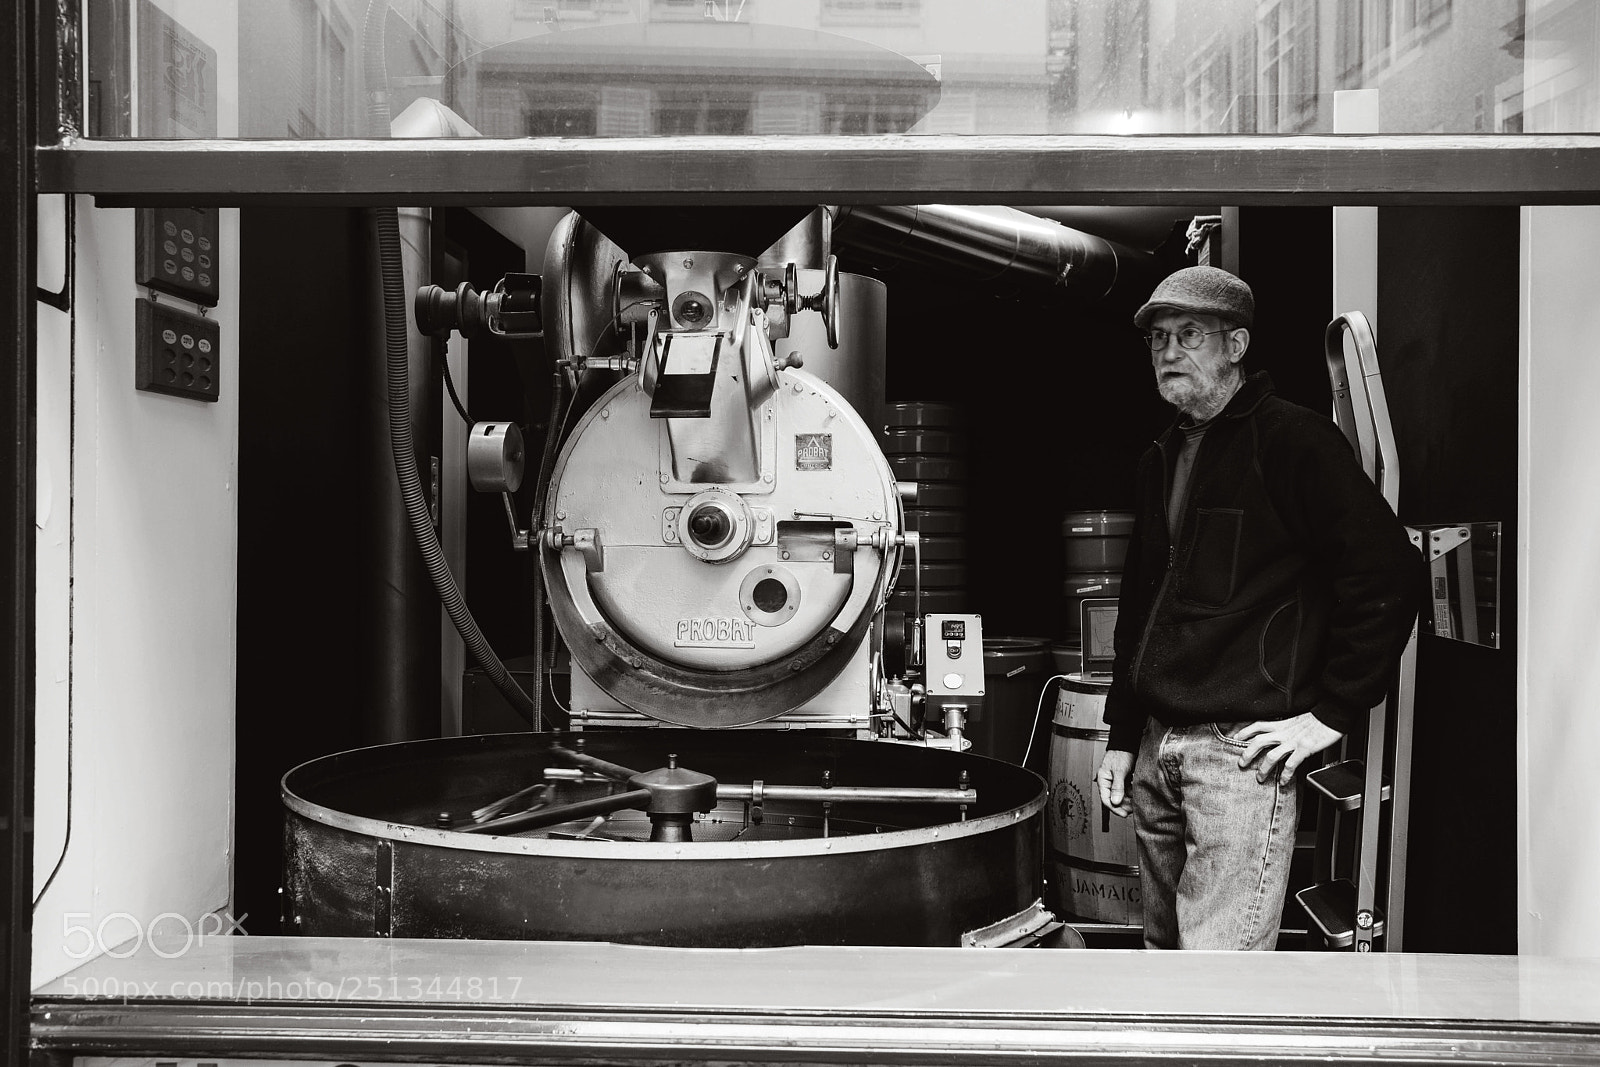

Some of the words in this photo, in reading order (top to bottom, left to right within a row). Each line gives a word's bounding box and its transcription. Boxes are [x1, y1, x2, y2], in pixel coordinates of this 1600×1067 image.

[797, 446, 829, 458] PROBAT
[677, 618, 757, 642] PROBAT
[1072, 878, 1141, 903] JAMAIC
